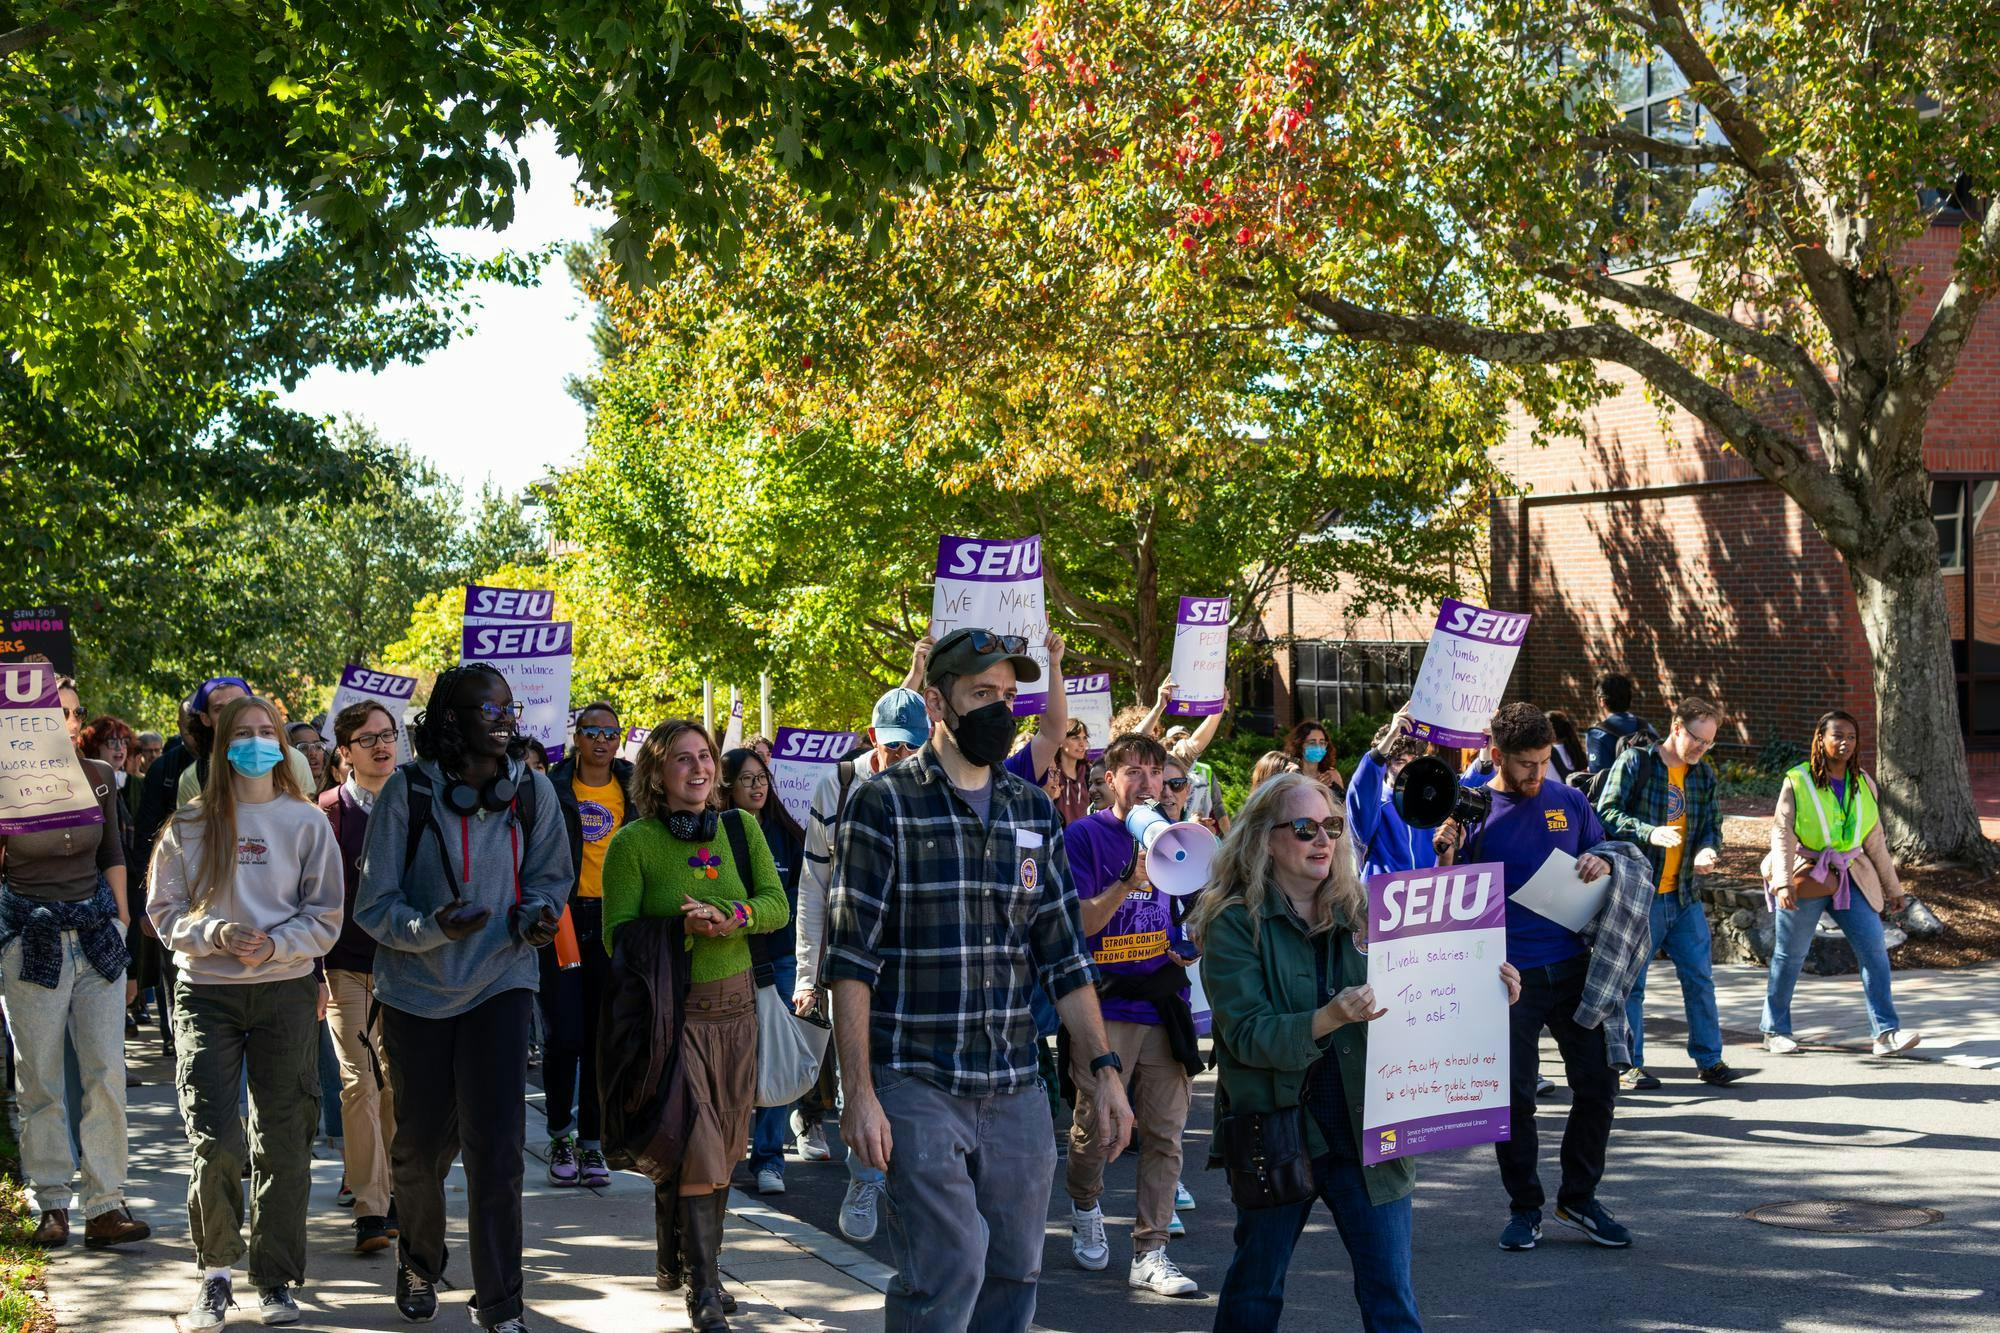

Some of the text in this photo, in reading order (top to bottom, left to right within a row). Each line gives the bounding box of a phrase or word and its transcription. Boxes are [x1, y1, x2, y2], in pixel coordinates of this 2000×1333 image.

[949, 541, 1039, 576] SEIU
[473, 589, 551, 617] SEIU
[941, 583, 1037, 614] WE MAKE
[11, 619, 64, 632] UNION
[1446, 607, 1527, 642] SEIU
[473, 626, 566, 656] SEIU
[1446, 639, 1480, 663] Jumbo
[521, 663, 554, 676] balance
[1451, 661, 1477, 684] loves
[347, 669, 413, 696] SEIU
[1064, 676, 1104, 693] EIU
[10, 739, 36, 751] FOR
[781, 732, 854, 760] SEIU
[0, 758, 71, 771] WORKERS!
[1546, 820, 1568, 830] SEIU
[1126, 891, 1153, 900] SEIU
[1379, 872, 1492, 932] SEIU
[1104, 937, 1134, 949] STRONG
[1095, 950, 1125, 962] STRONG
[1397, 984, 1456, 1005] Too much
[1406, 1010, 1417, 1027] to
[1378, 1052, 1497, 1079] Tufts faculty should not
[1386, 1075, 1499, 1102] be eligible for public housing
[1407, 1119, 1488, 1137] Service Employees International Union
[1380, 1142, 1396, 1153] SEIU
